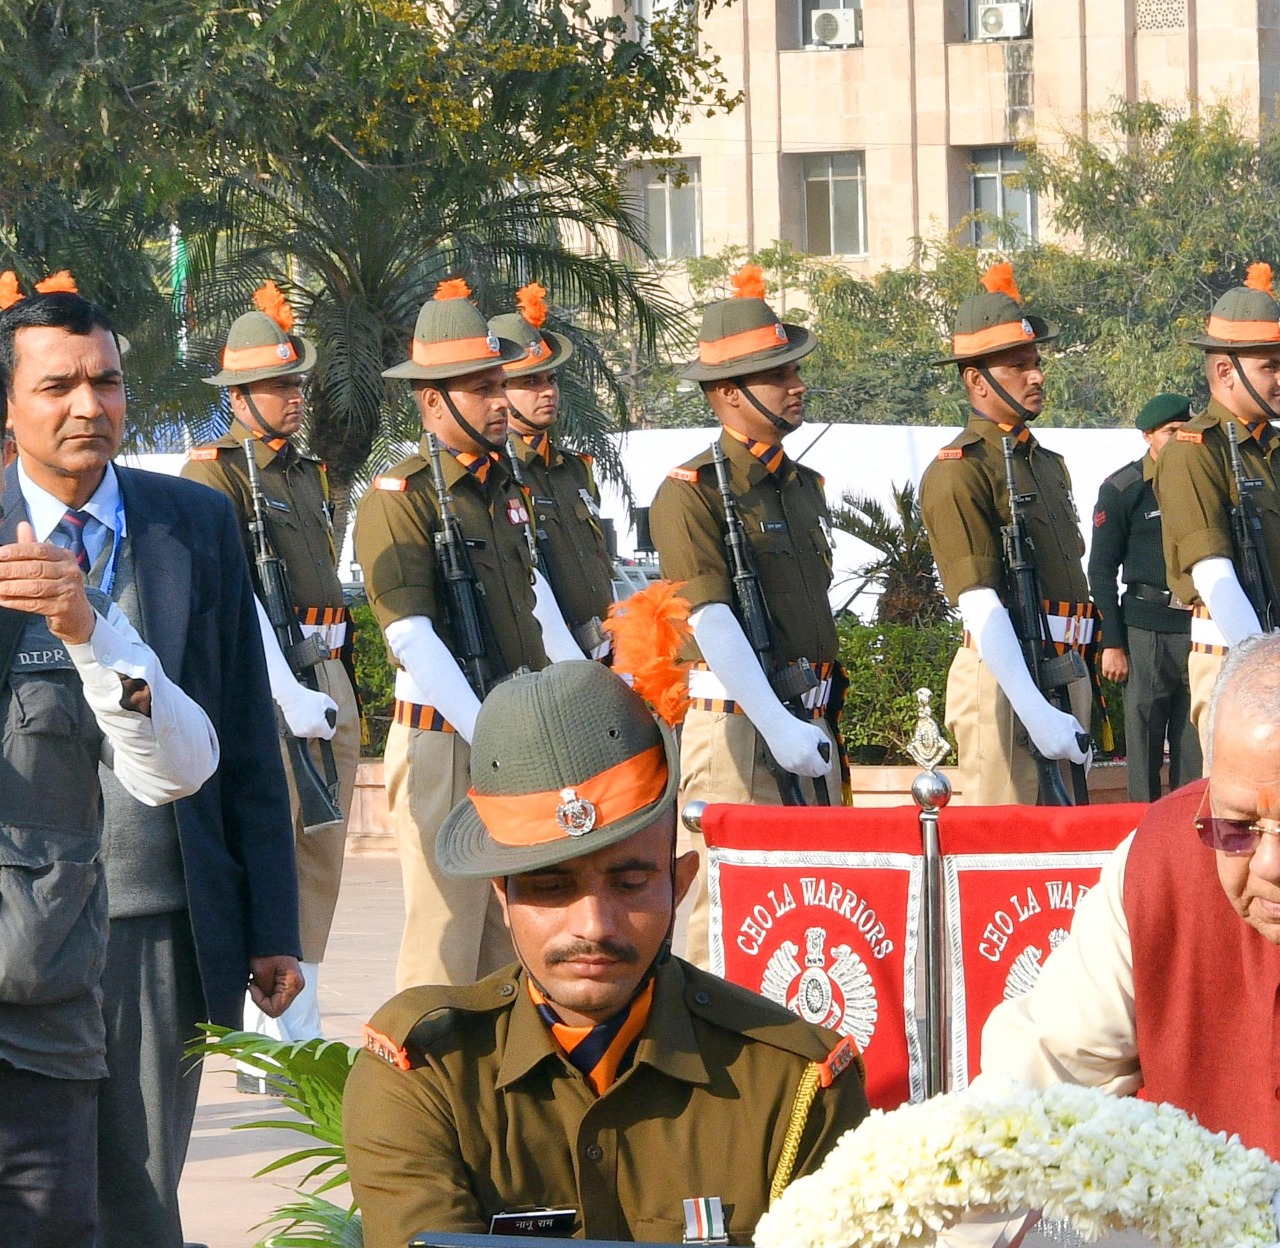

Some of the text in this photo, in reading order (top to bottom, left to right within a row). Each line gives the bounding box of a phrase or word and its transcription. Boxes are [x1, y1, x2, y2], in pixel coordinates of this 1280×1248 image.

[736, 877, 894, 960] CHO LA WARRIORS
[978, 914, 1014, 963] CHO
[1012, 886, 1042, 922] LA
[537, 1218, 554, 1228] राम
